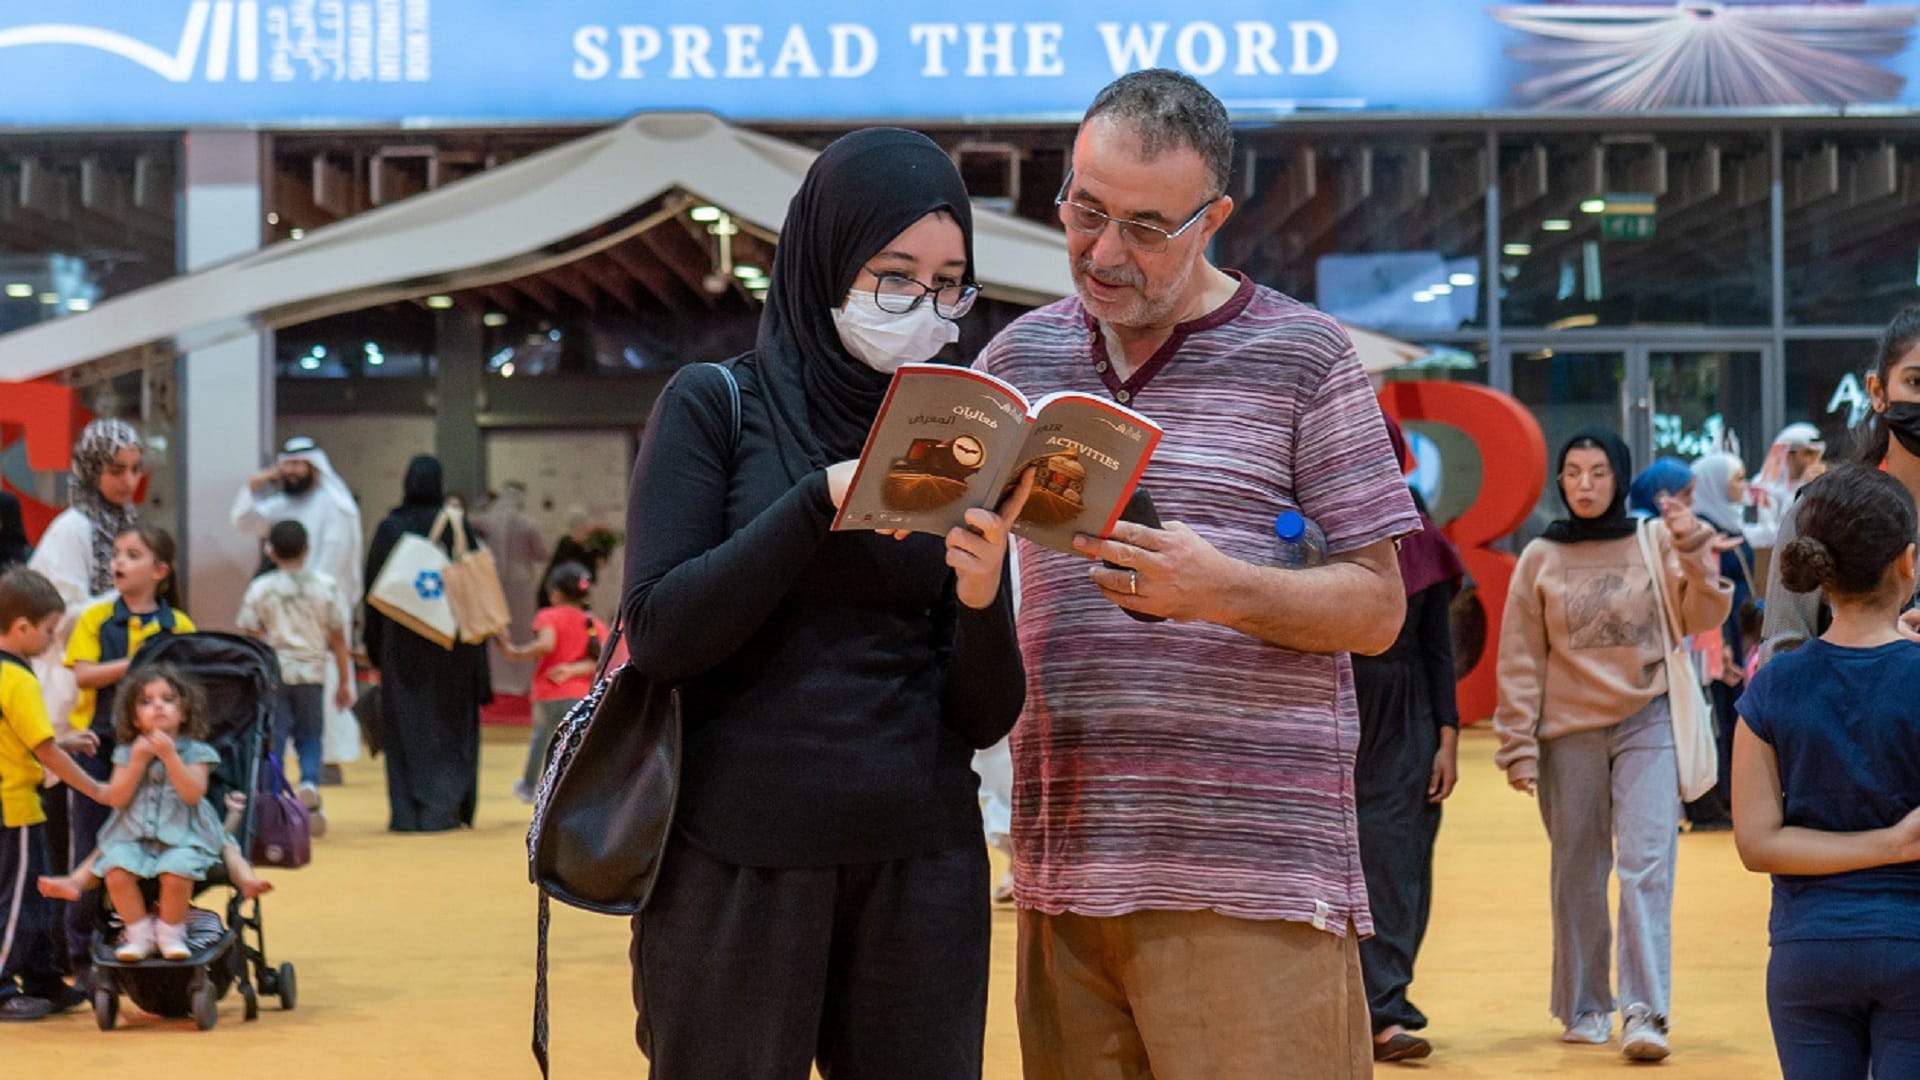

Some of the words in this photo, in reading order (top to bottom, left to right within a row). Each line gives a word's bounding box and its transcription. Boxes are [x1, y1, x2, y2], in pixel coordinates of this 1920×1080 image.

[573, 23, 877, 79] SPREAD
[910, 23, 1064, 77] THE
[1098, 21, 1337, 77] WORD
[908, 414, 956, 426] المعرض
[952, 405, 999, 429] فعاليات
[1046, 436, 1121, 471] ACTIVITIES
